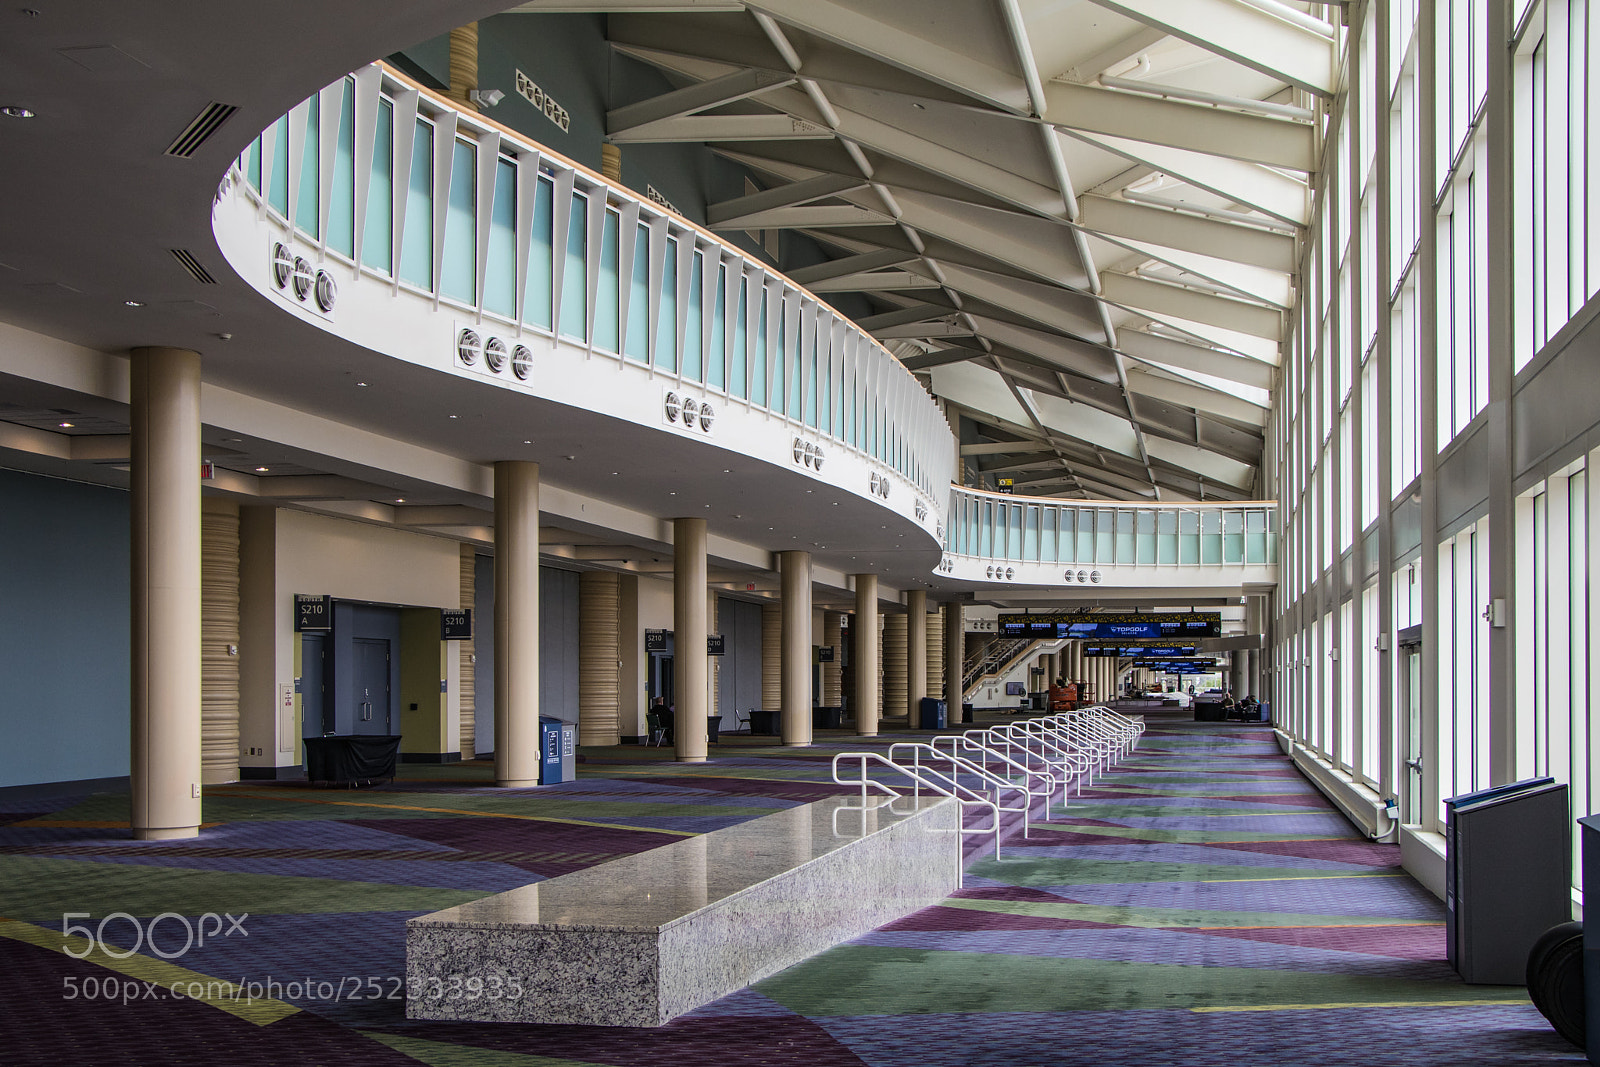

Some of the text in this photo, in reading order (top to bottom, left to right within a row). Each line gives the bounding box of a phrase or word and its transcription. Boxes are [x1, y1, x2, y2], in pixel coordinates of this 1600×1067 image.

[301, 605, 323, 614] S210
[302, 617, 308, 625] A
[445, 617, 465, 625] S210
